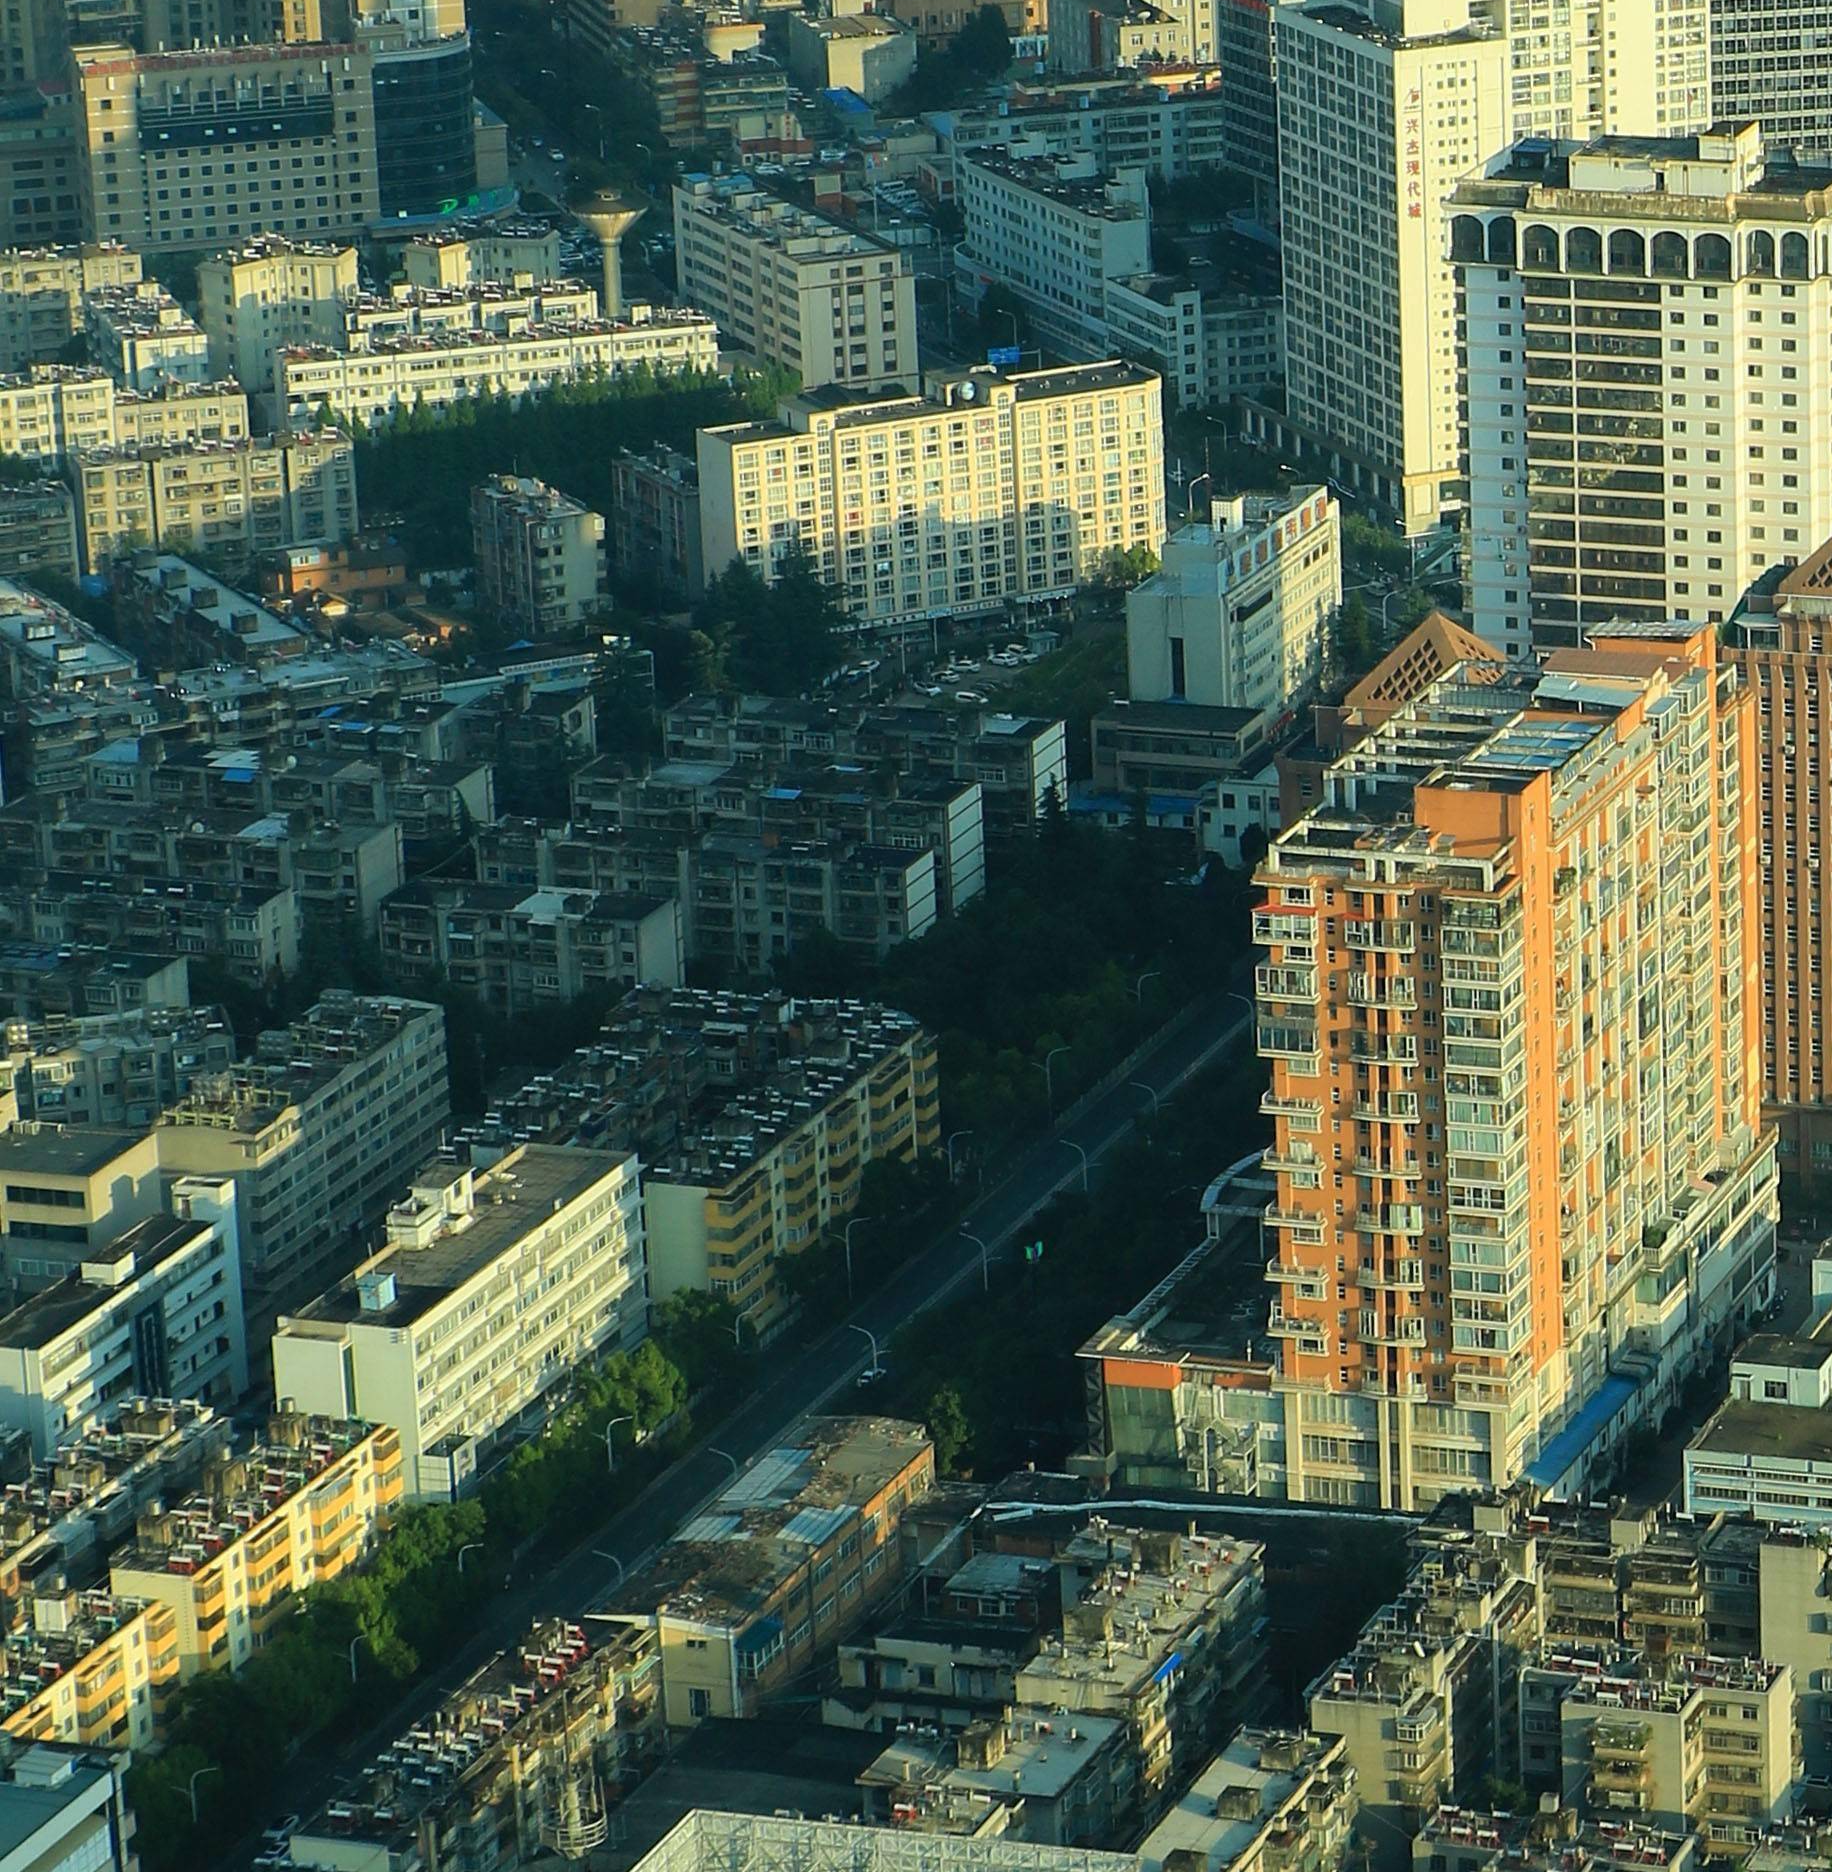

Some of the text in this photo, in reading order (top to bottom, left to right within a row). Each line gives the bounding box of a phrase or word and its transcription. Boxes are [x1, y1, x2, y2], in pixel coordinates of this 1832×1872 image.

[1405, 118, 1422, 219] 兴杰现代城
